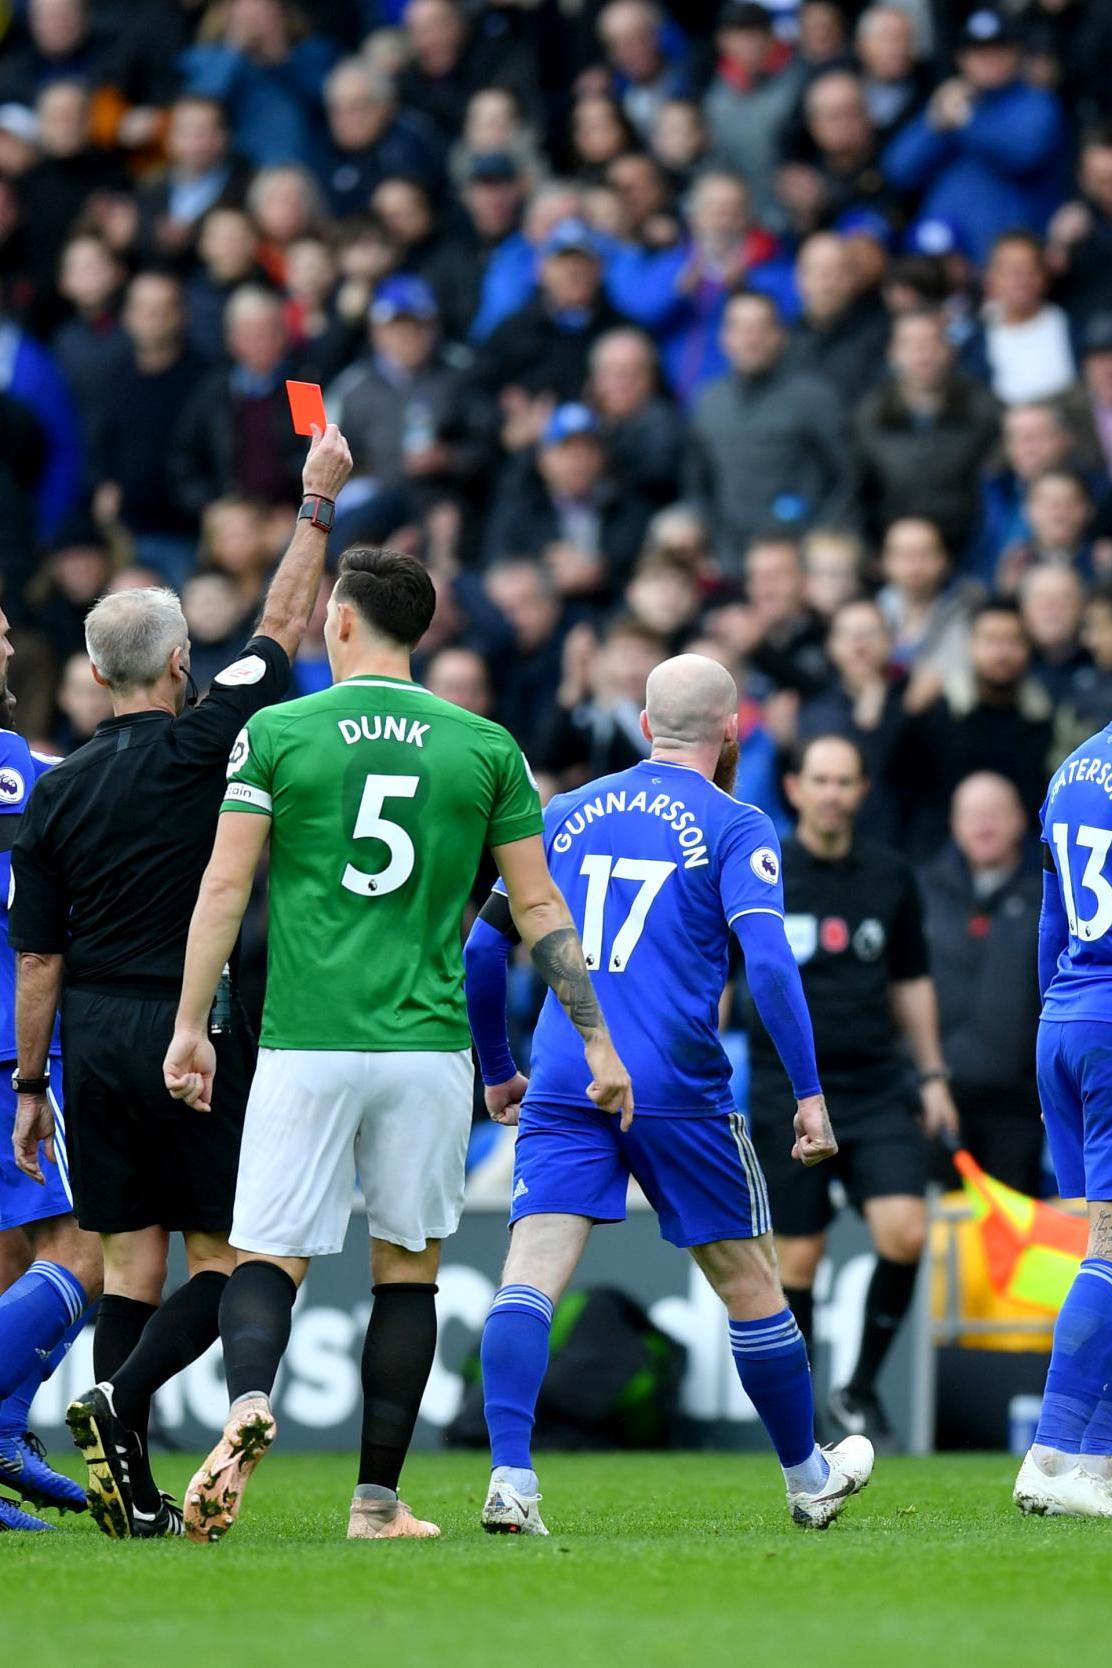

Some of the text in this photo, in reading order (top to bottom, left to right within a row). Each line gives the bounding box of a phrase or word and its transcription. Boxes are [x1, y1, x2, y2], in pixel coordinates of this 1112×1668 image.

[337, 715, 431, 748] DUNK
[341, 774, 420, 897] 5
[553, 790, 709, 870] GUNNARSSON
[579, 854, 678, 973] 17
